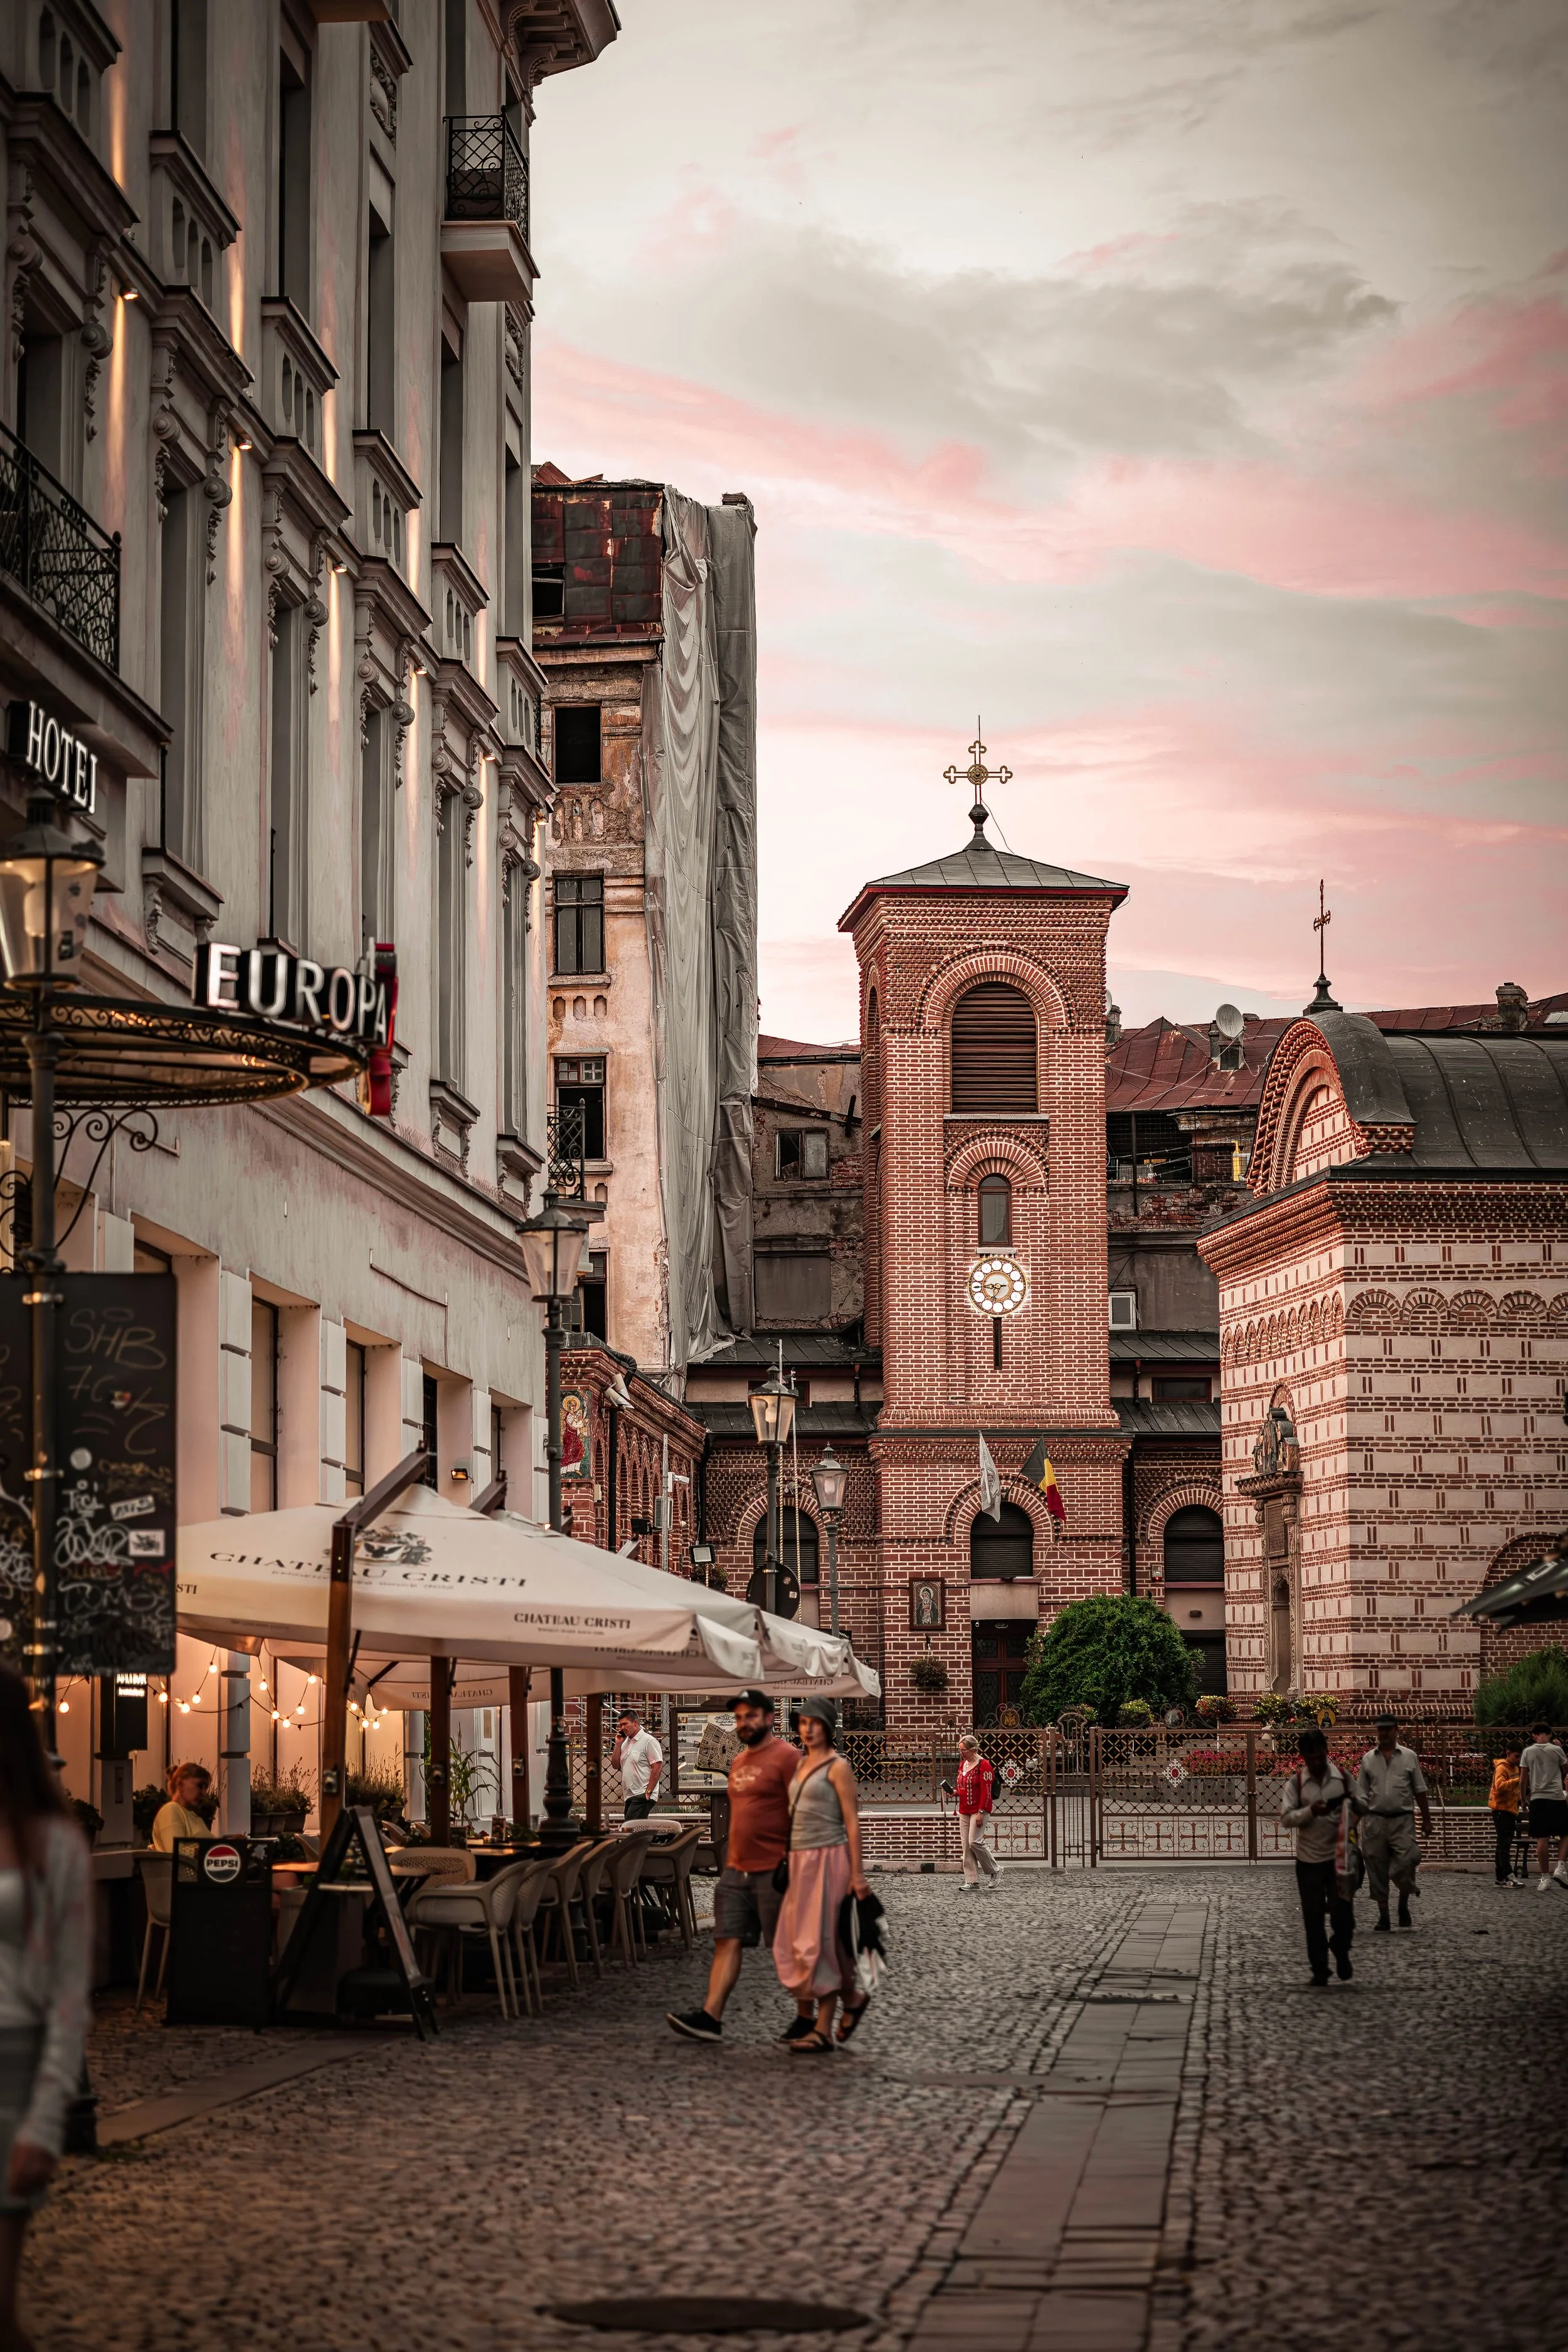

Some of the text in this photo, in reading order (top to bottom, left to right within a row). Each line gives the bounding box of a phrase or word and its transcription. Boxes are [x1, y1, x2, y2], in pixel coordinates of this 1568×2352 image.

[207, 942, 387, 1046] EUROPA
[210, 1552, 388, 1579] CHATEU
[402, 1572, 527, 1587] CRISTI
[176, 1583, 198, 1595] STI
[514, 1612, 631, 1629] CHATEAU CRISTI
[206, 1859, 238, 1868] PEPSI
